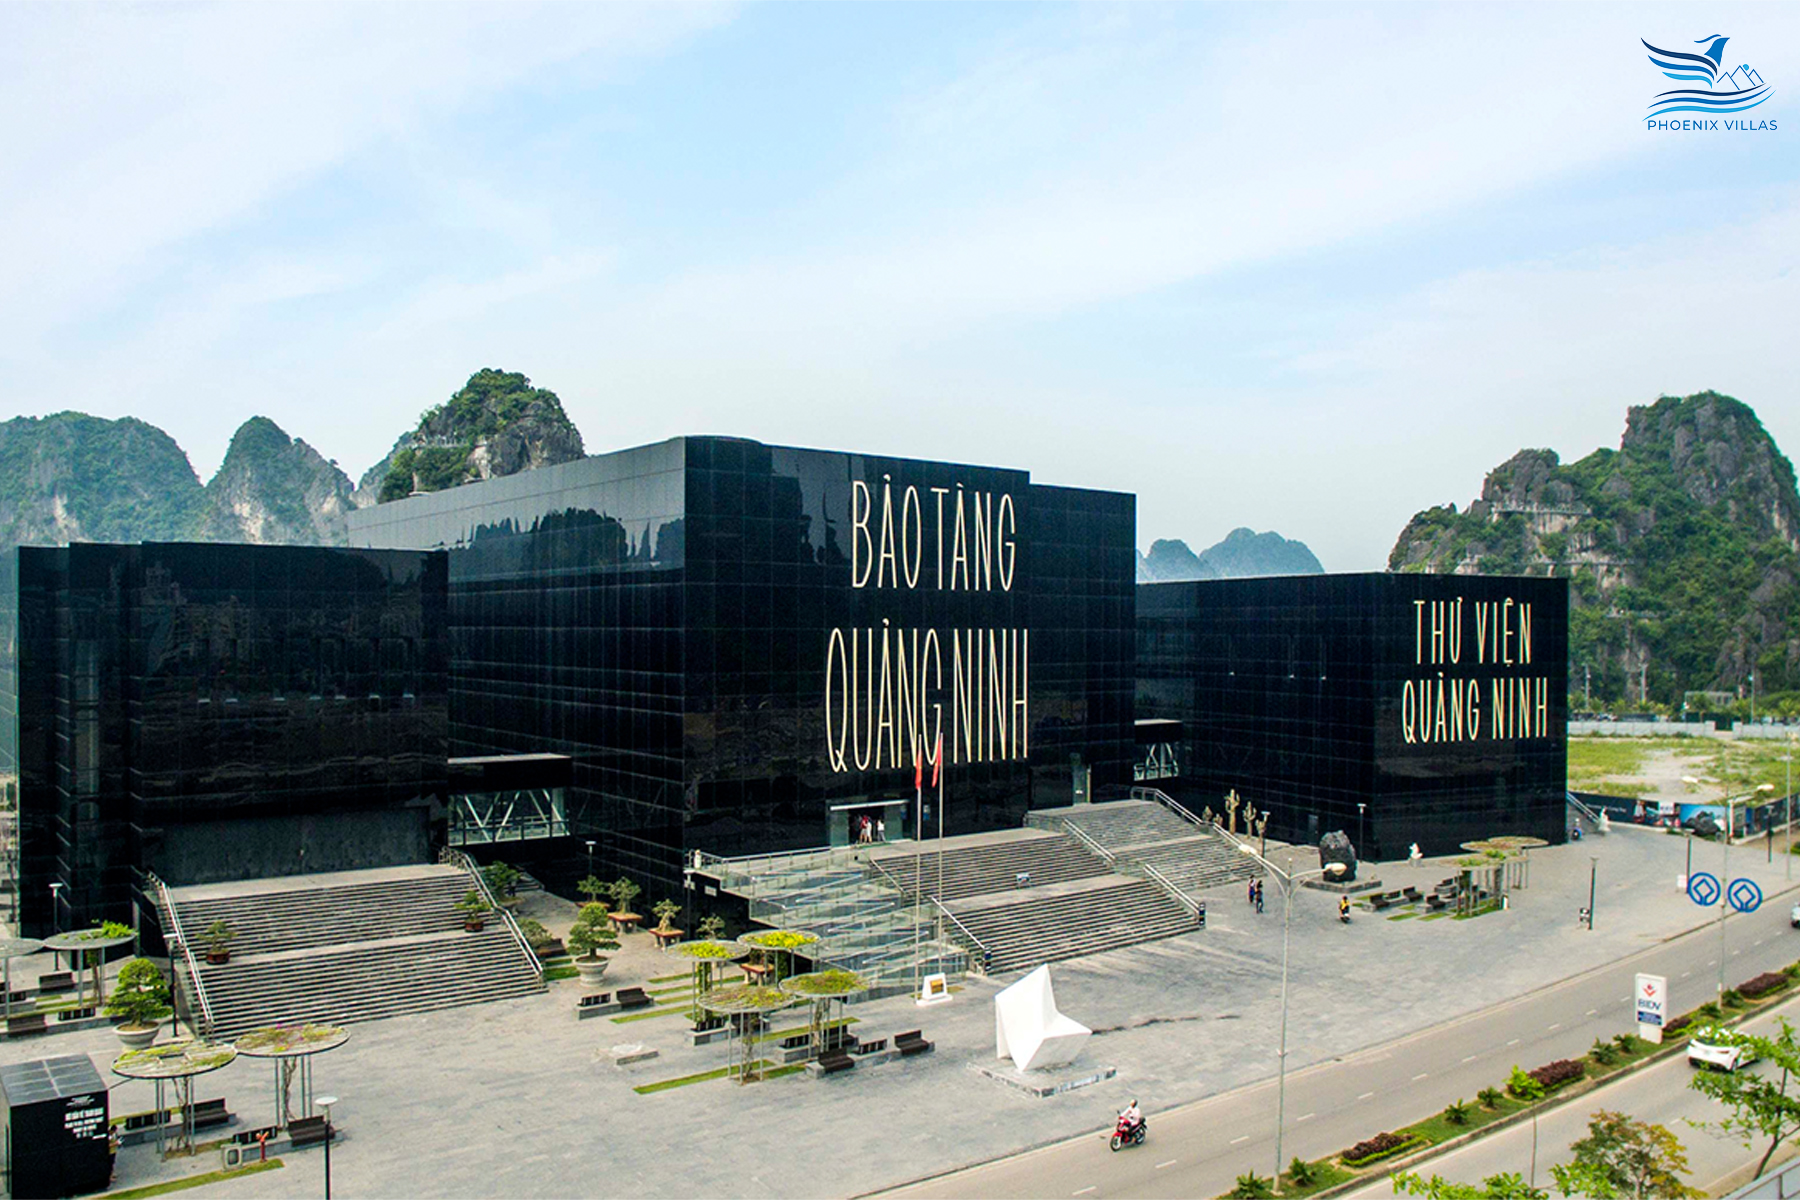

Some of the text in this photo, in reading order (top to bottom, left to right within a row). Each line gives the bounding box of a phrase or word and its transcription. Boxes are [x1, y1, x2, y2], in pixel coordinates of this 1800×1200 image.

[852, 473, 1016, 592] BẢO TÀNG
[1413, 596, 1532, 667] THƯ VIỆN
[825, 617, 1028, 773] QUẢNG NINH
[1402, 672, 1548, 744] QUẢNG NINH
[1637, 998, 1662, 1011] BIDV
